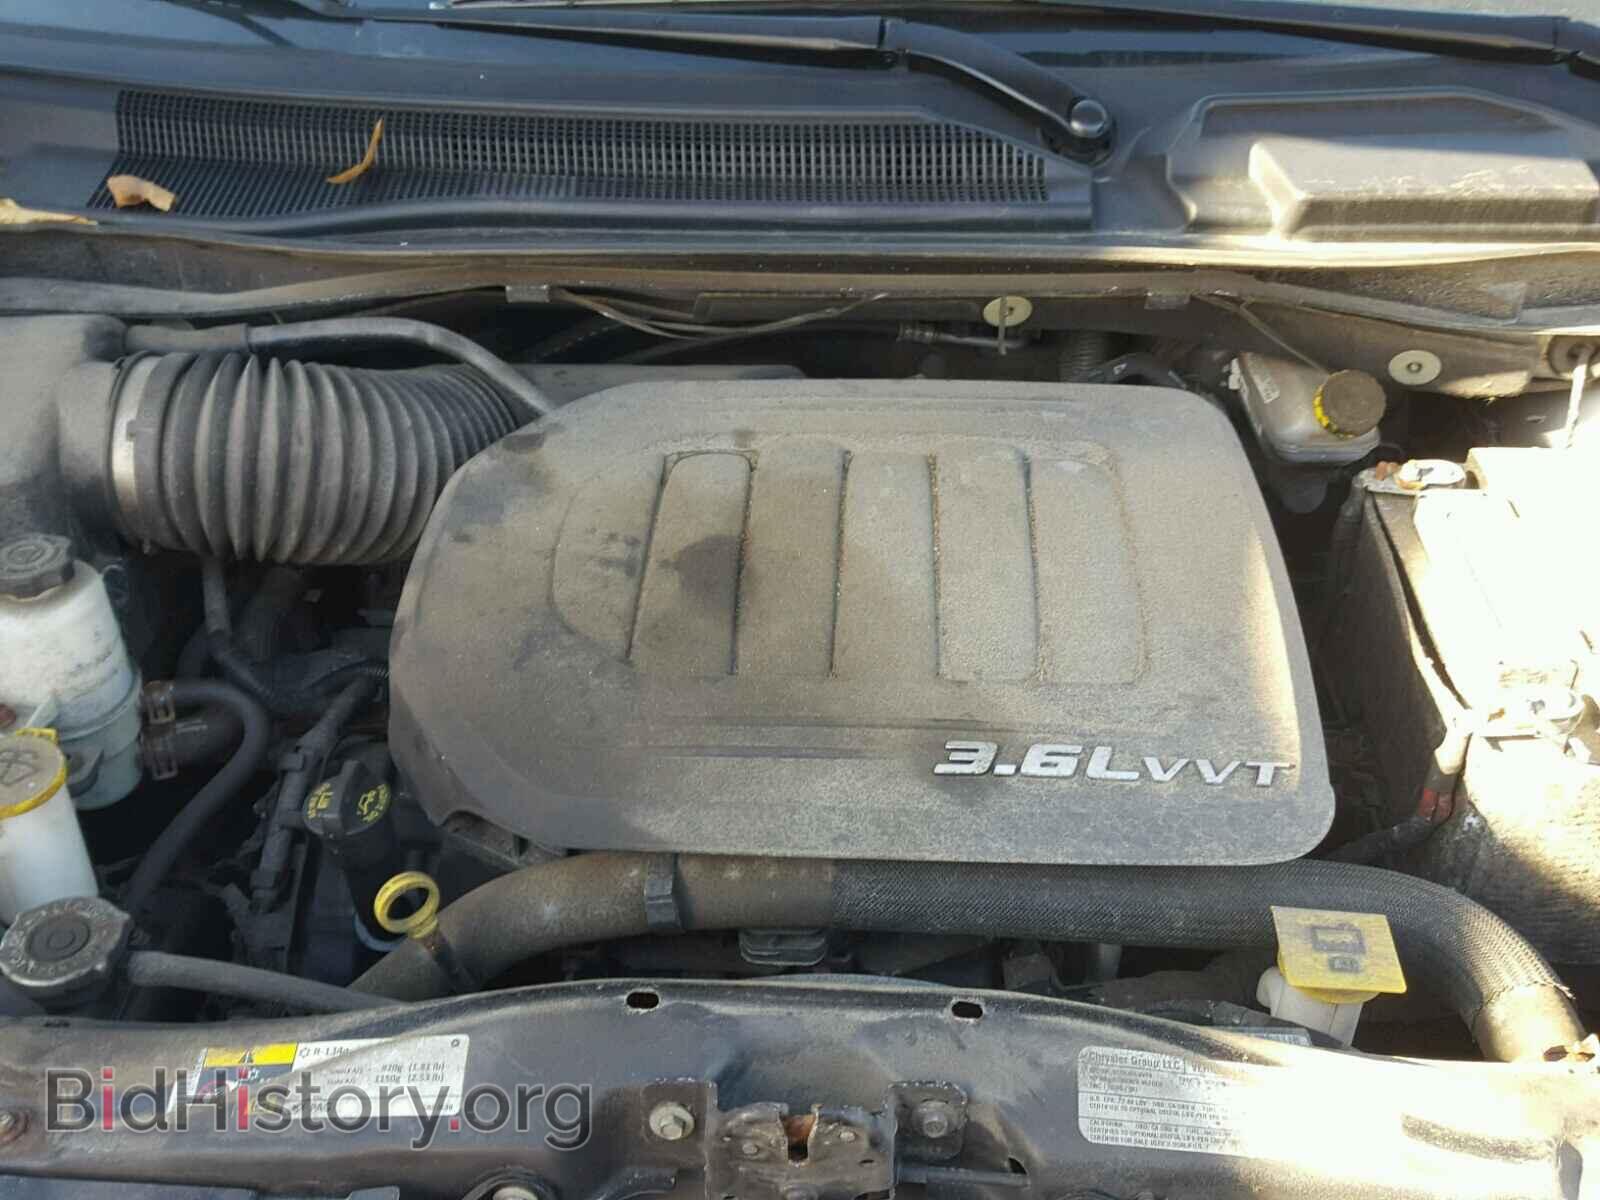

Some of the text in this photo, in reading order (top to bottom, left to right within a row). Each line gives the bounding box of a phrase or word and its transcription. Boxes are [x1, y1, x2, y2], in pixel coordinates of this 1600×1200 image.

[1089, 1051, 1181, 1070] Chrysler Group LLC
